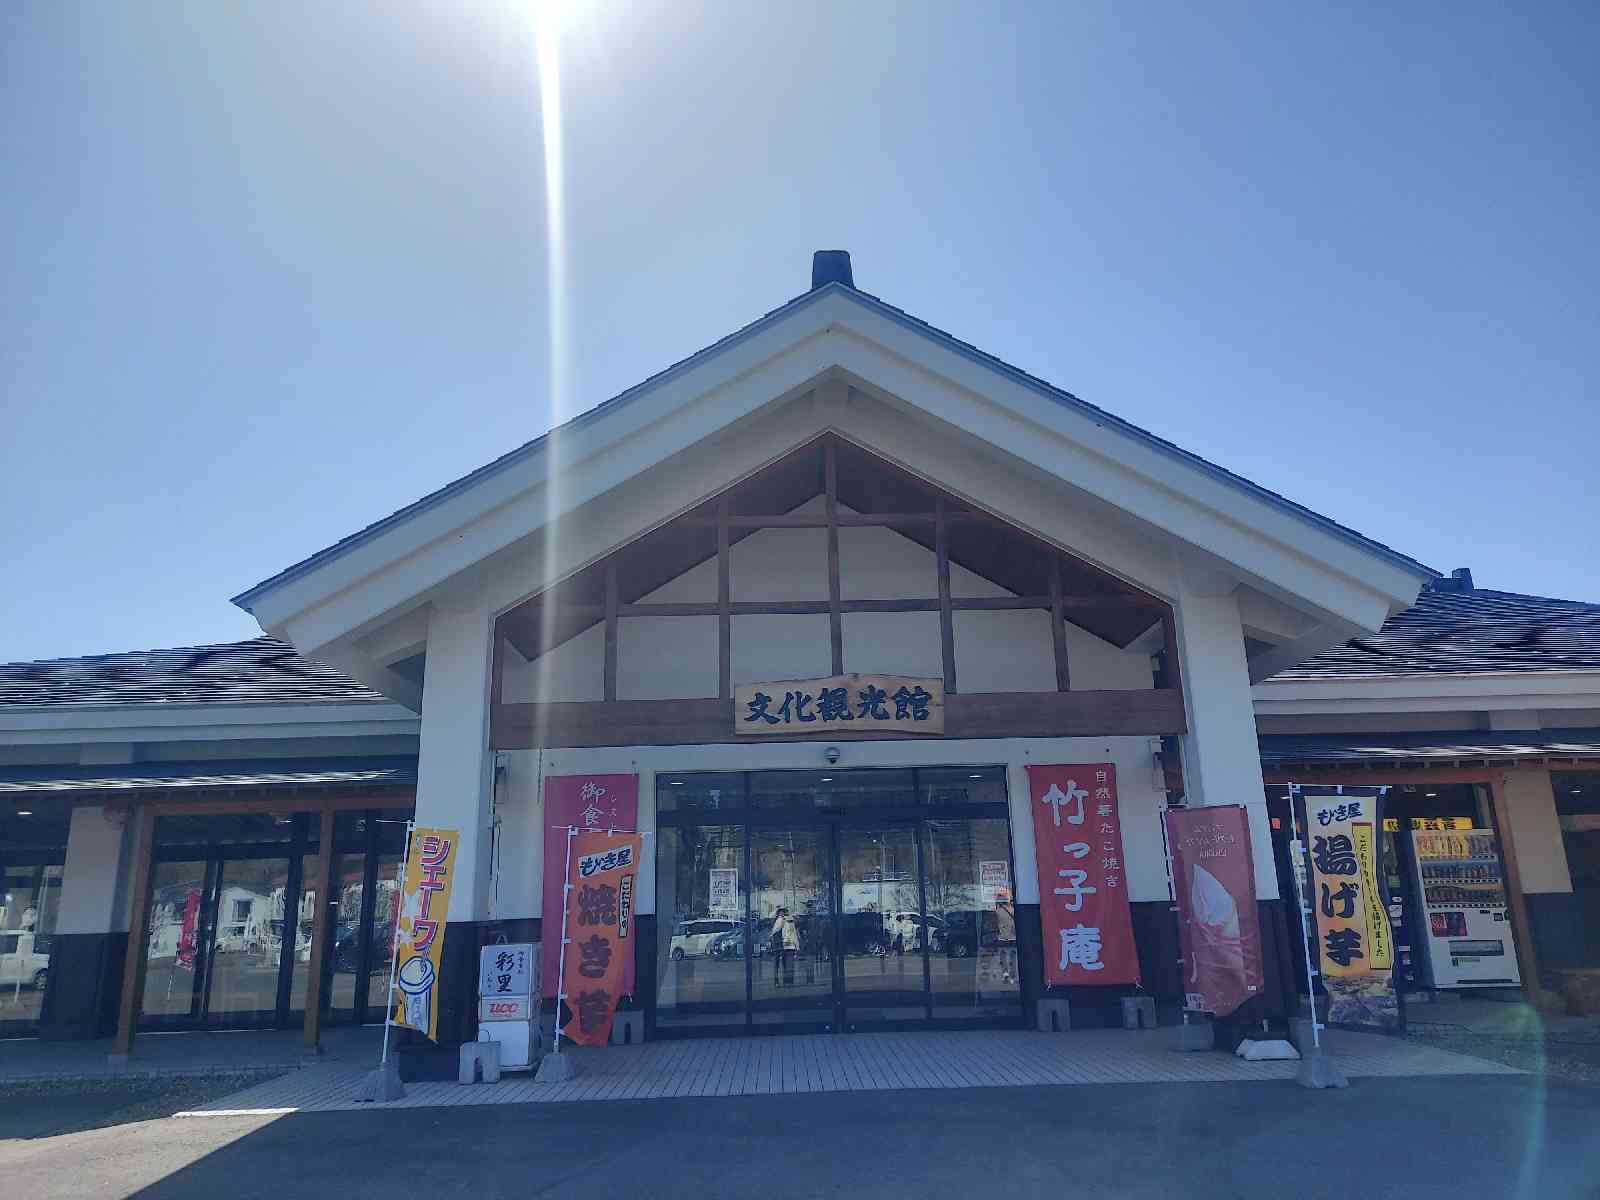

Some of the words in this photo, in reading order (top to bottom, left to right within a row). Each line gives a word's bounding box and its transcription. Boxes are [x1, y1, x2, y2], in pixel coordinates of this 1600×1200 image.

[743, 684, 933, 724] 文化観光館
[1042, 779, 1104, 971] 竹っ子庵
[1312, 834, 1364, 967] 揚げ芋
